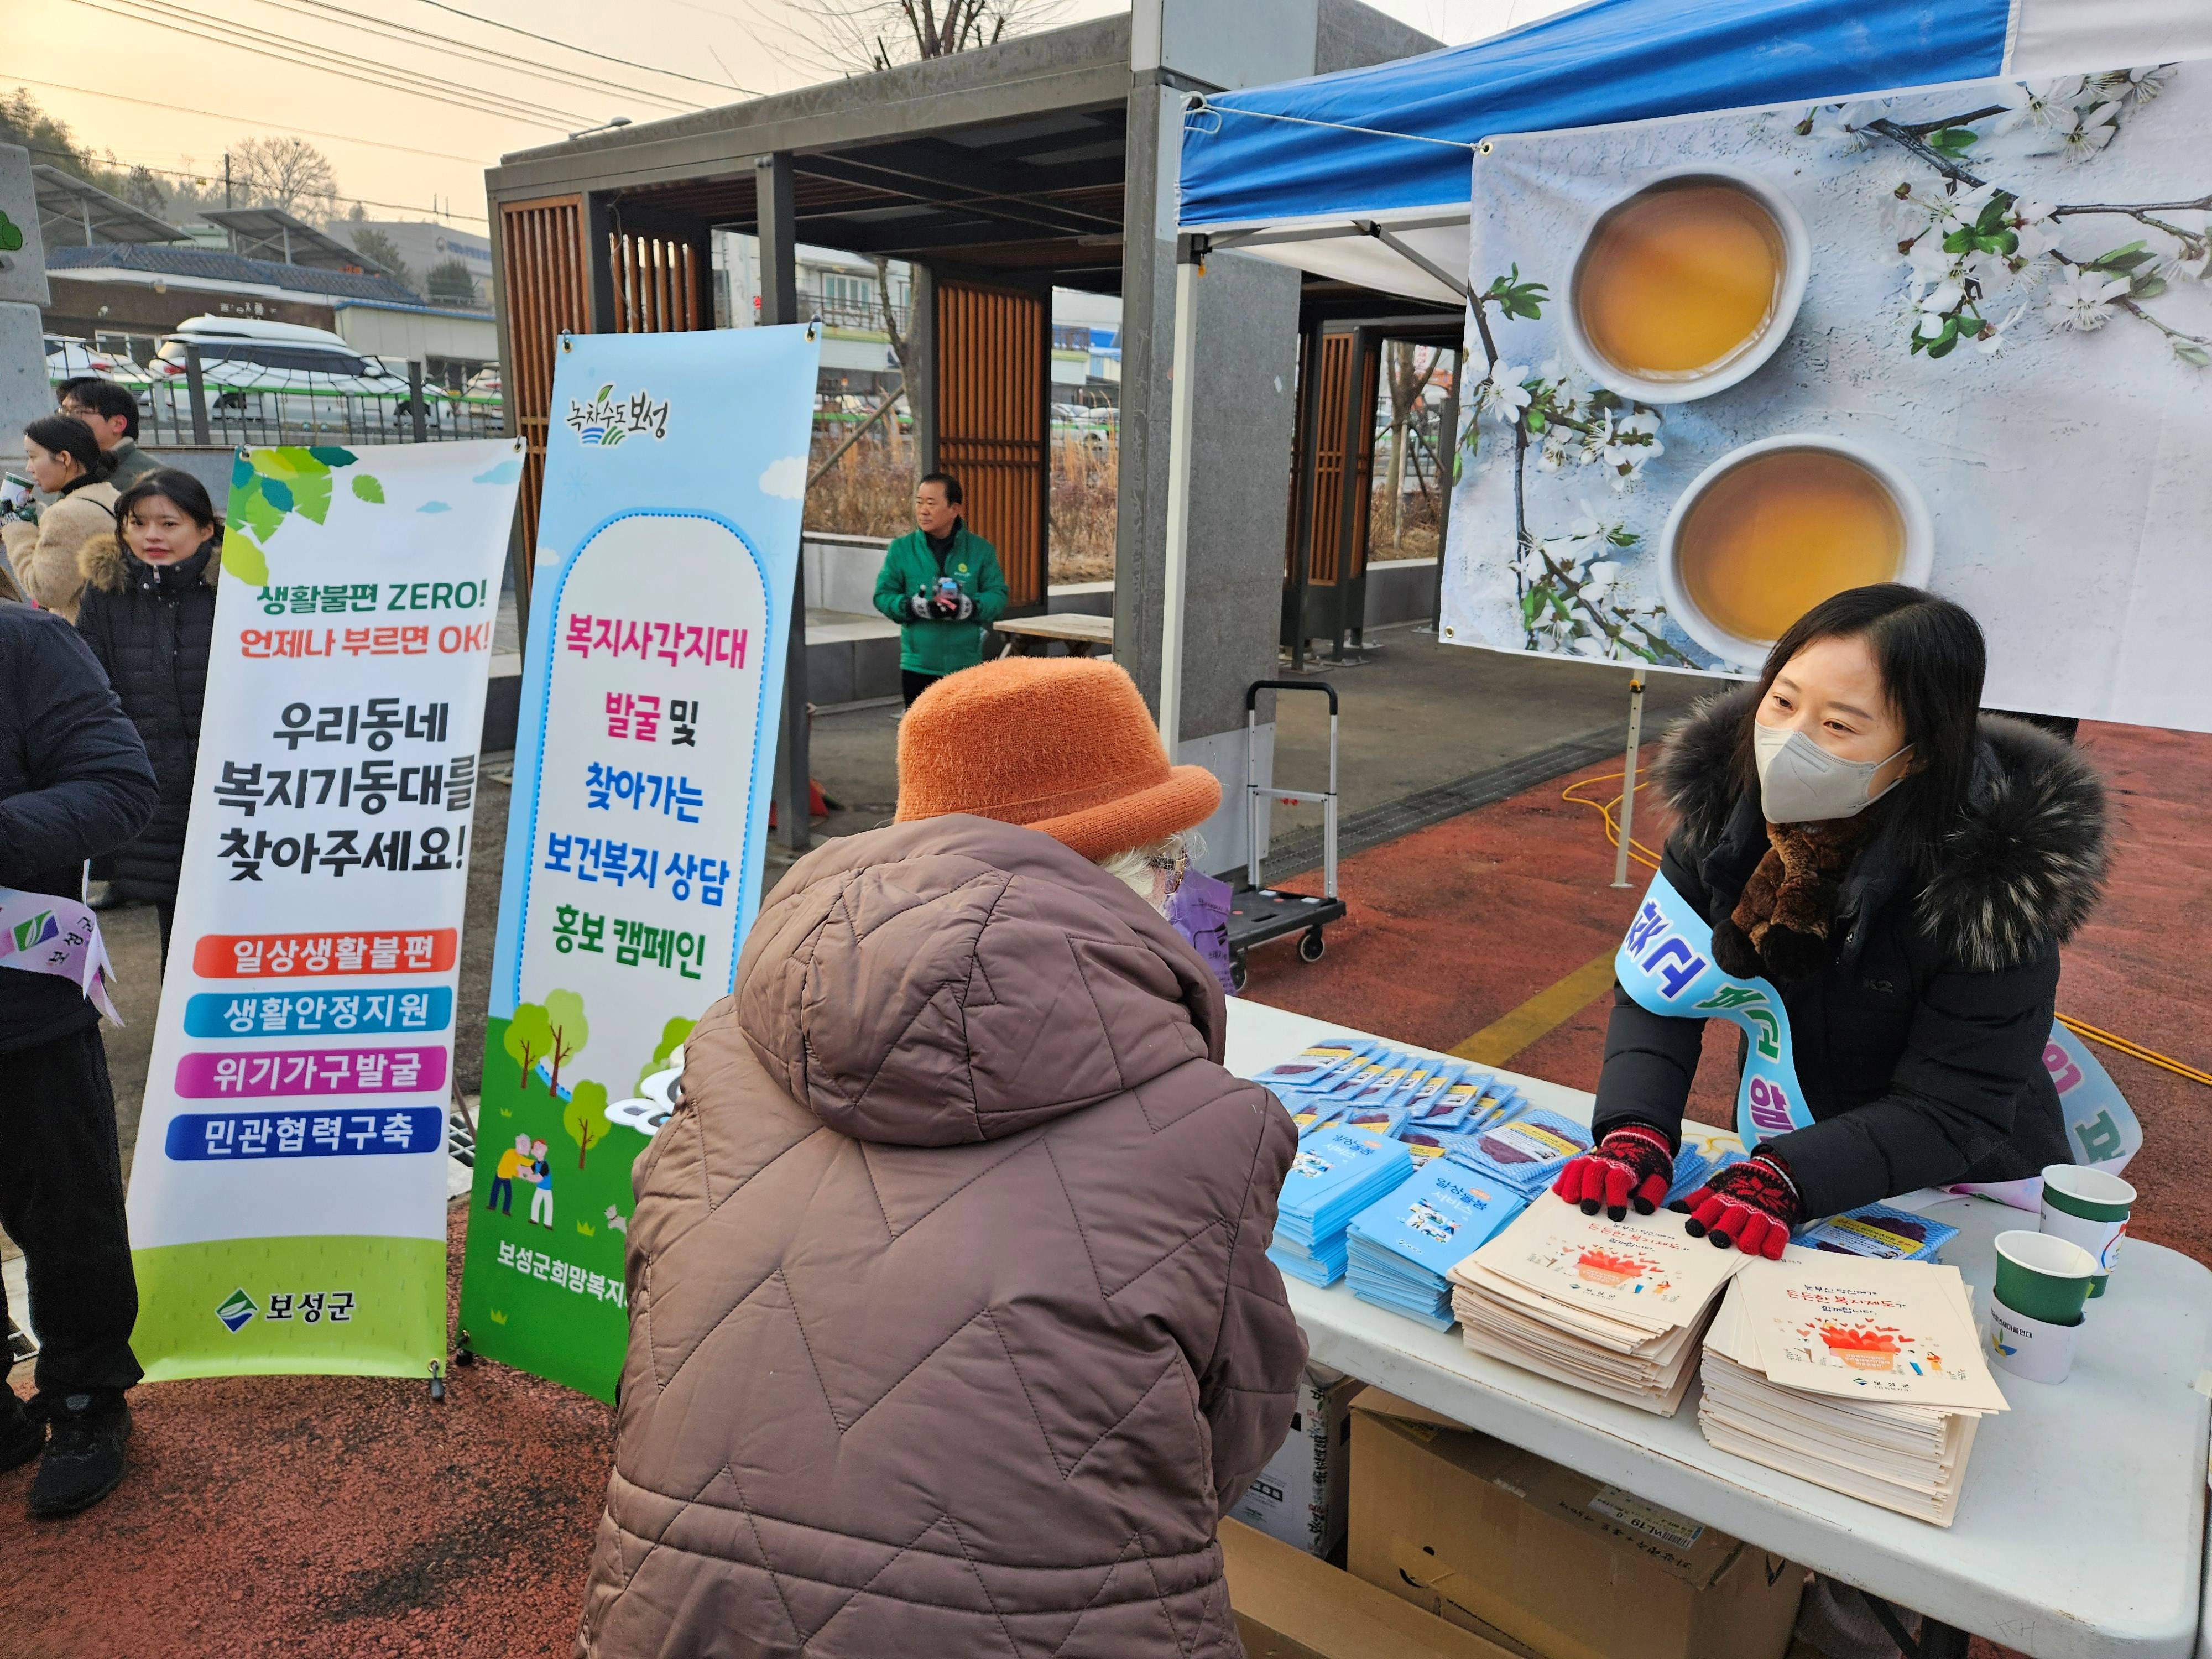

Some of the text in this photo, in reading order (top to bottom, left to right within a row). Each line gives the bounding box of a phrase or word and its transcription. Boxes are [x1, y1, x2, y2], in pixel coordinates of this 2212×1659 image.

[567, 392, 668, 439] 녹차수도 보성
[257, 580, 487, 615] 생활불편 ZERO!
[240, 621, 490, 658] 언제나 부르면 OK!
[566, 613, 748, 669] 복지사각지대
[273, 698, 450, 751] 우리동네
[605, 691, 699, 747] 발굴 및
[213, 754, 476, 816] 복지기동대를
[585, 761, 703, 823] 찾아가는
[217, 825, 465, 881] 찾아주세요!
[544, 832, 730, 907] 보건복지 상담
[233, 935, 434, 973] 일상생활불편
[552, 904, 706, 980] 홍보 캠페인
[223, 993, 429, 1032] 생활안정지원
[213, 1052, 421, 1091] 위기가구발굴
[205, 1114, 414, 1155] 민관협력구축
[1436, 1178, 1488, 1211] 일상돌봄
[498, 1240, 628, 1309] 보성군희망복지
[266, 1292, 354, 1322] 보성군
[1787, 1290, 1906, 1308] 든든한 복지제도가
